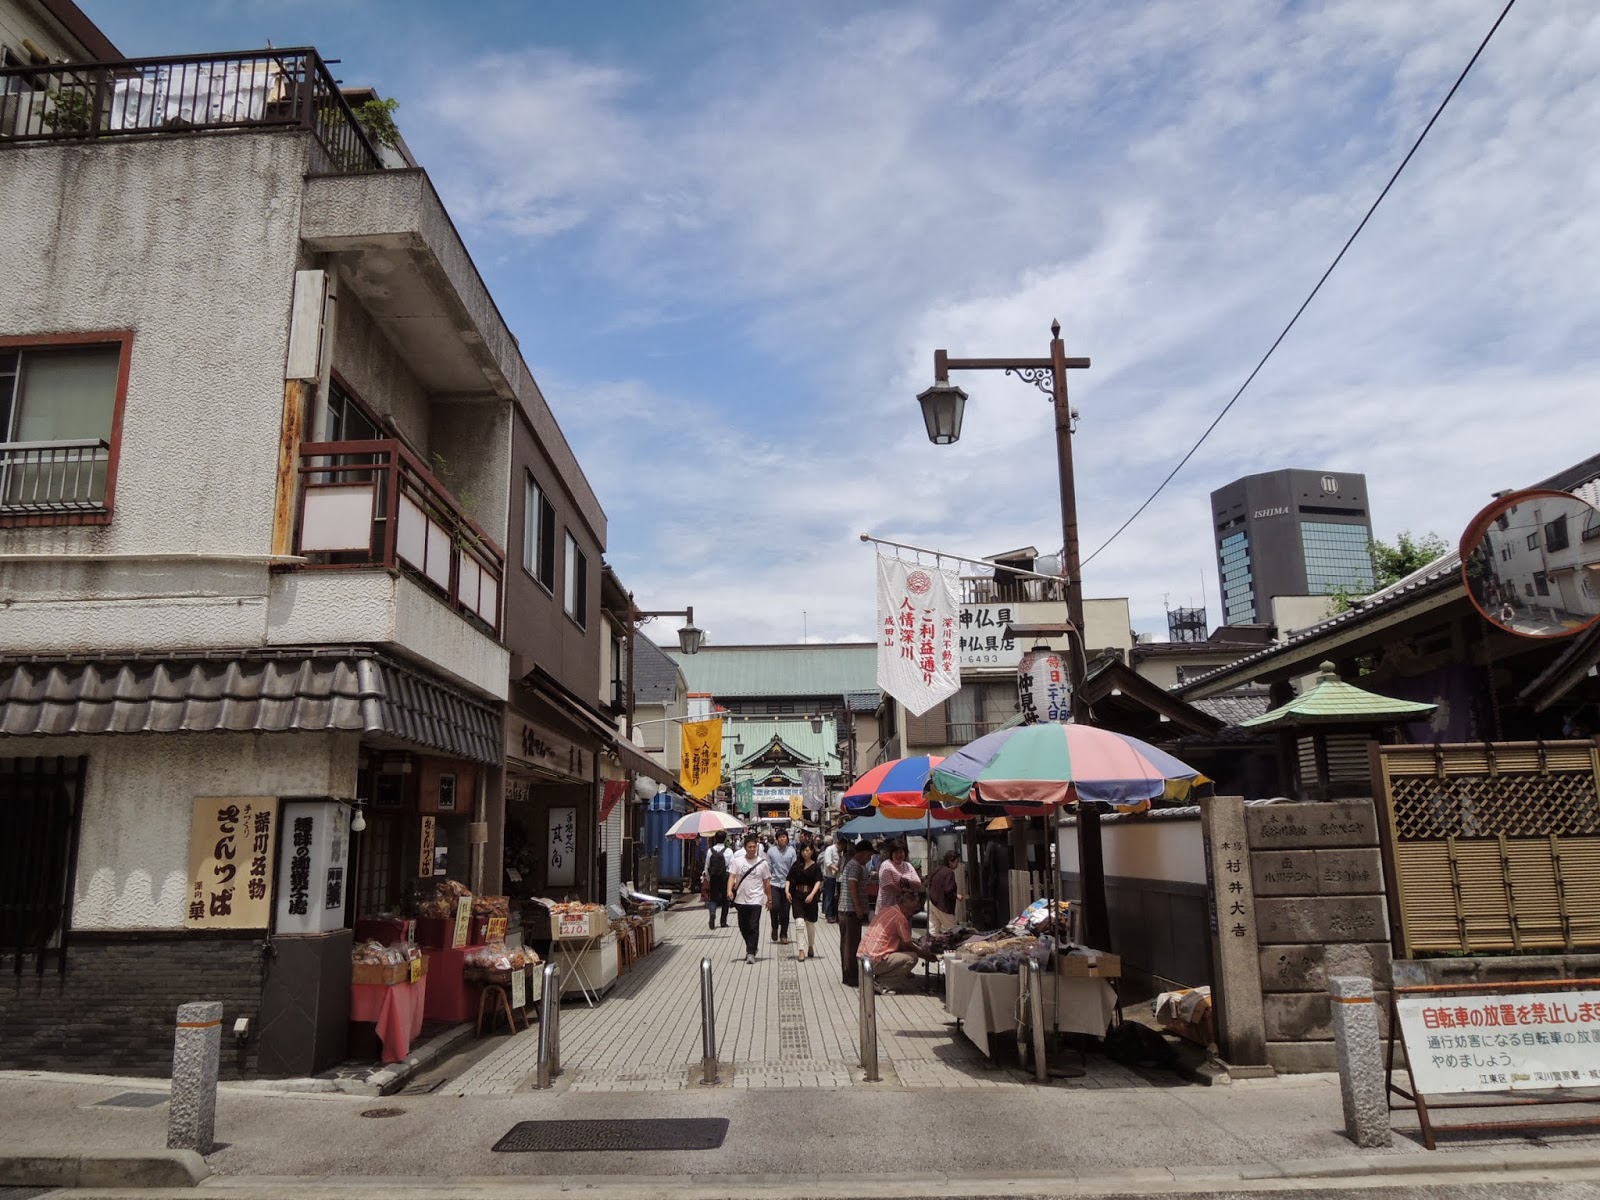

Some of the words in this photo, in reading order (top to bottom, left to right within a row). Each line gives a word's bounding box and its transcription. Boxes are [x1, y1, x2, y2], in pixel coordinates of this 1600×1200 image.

[1254, 506, 1289, 519] ISHIMA
[884, 616, 895, 647] 成田山
[899, 597, 916, 661] 人情深川
[919, 608, 936, 687] ご利益通り
[942, 618, 954, 672] 深川不動堂
[1046, 655, 1061, 683] 縁日
[1047, 684, 1060, 720] 二十八日
[701, 741, 710, 774] 人情深川
[209, 805, 240, 917] きんつば
[248, 811, 271, 900] 深川名物
[1226, 859, 1247, 937] 村井大吉
[1479, 1073, 1508, 1084] 江東区
